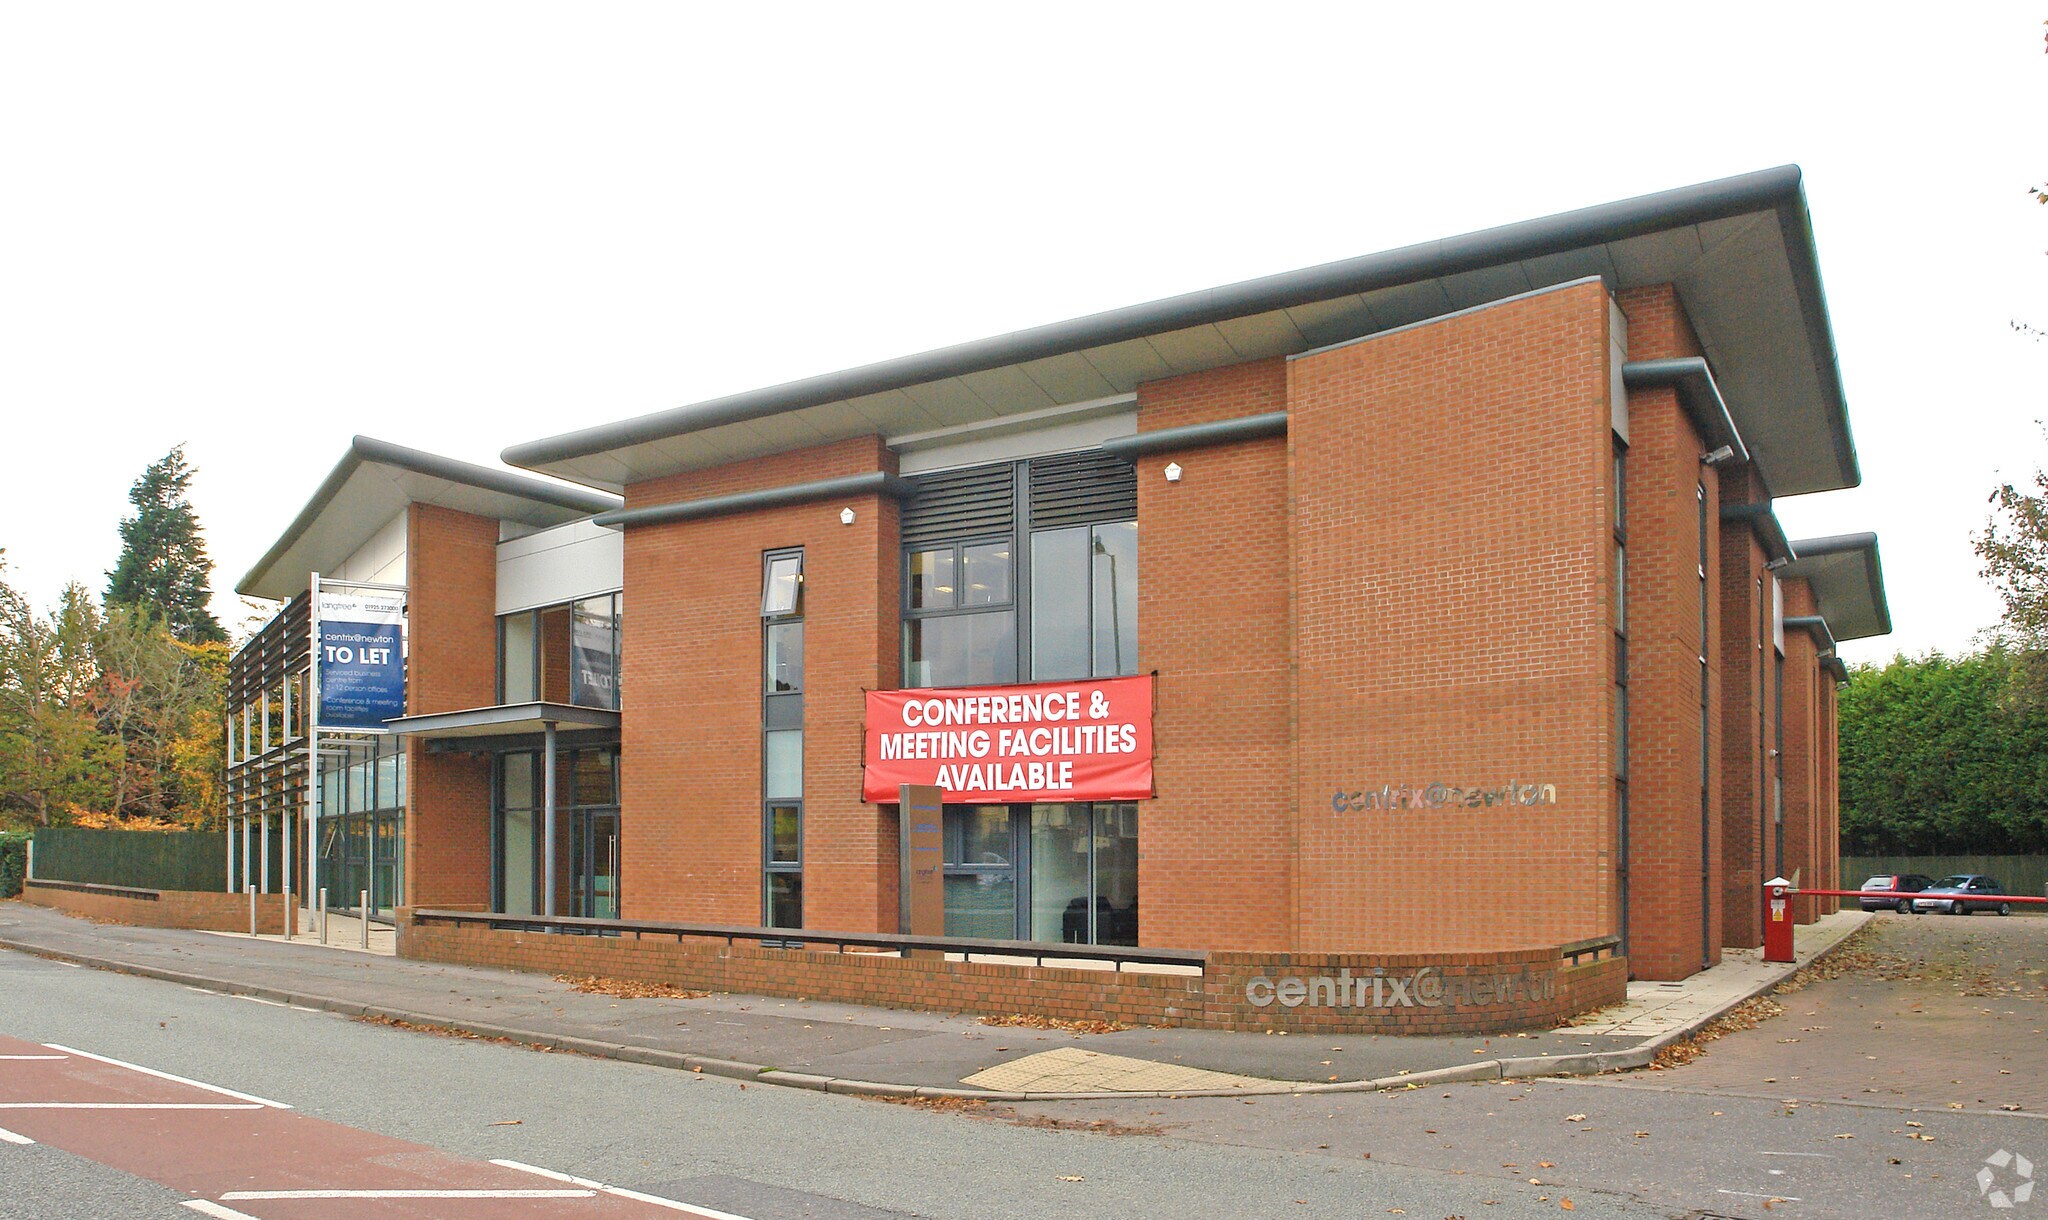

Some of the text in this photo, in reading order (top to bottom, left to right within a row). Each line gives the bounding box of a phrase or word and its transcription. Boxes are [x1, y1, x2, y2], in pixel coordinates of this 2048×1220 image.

[325, 633, 394, 643] centrix@newton
[325, 646, 390, 665] TO LET
[902, 689, 1111, 727] CONFERENCE &
[880, 723, 1137, 760] MEETING FACILITIES
[934, 760, 1074, 791] AVAILABLE
[1332, 777, 1557, 813] centrix@newton
[1246, 966, 1555, 1008] centrix@newton
